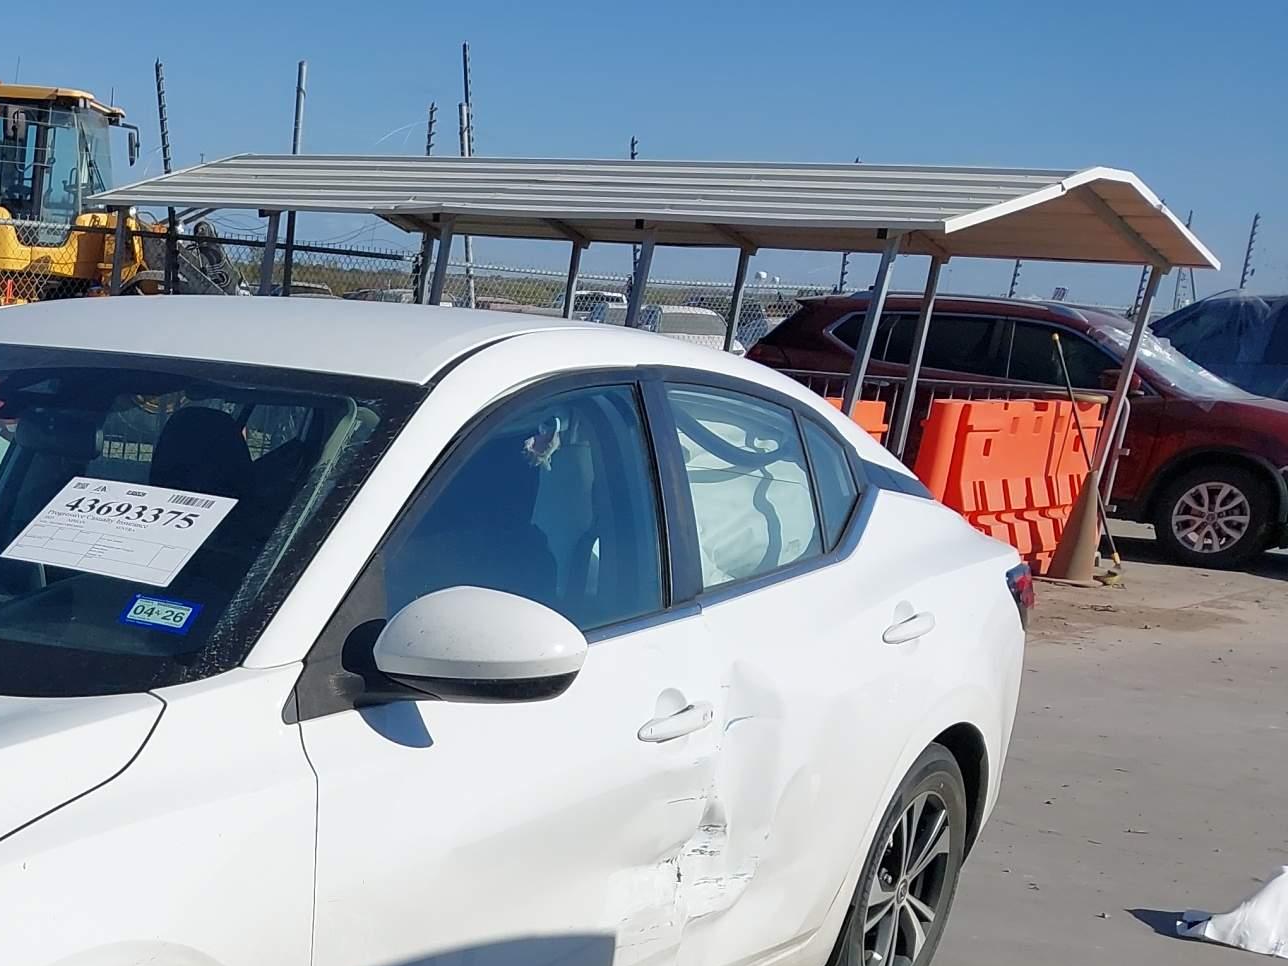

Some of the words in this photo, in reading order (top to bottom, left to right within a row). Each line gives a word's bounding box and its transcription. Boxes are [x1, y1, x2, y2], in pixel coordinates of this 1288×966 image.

[65, 496, 200, 530] 43693375
[132, 604, 155, 618] 04
[160, 609, 186, 623] 26
